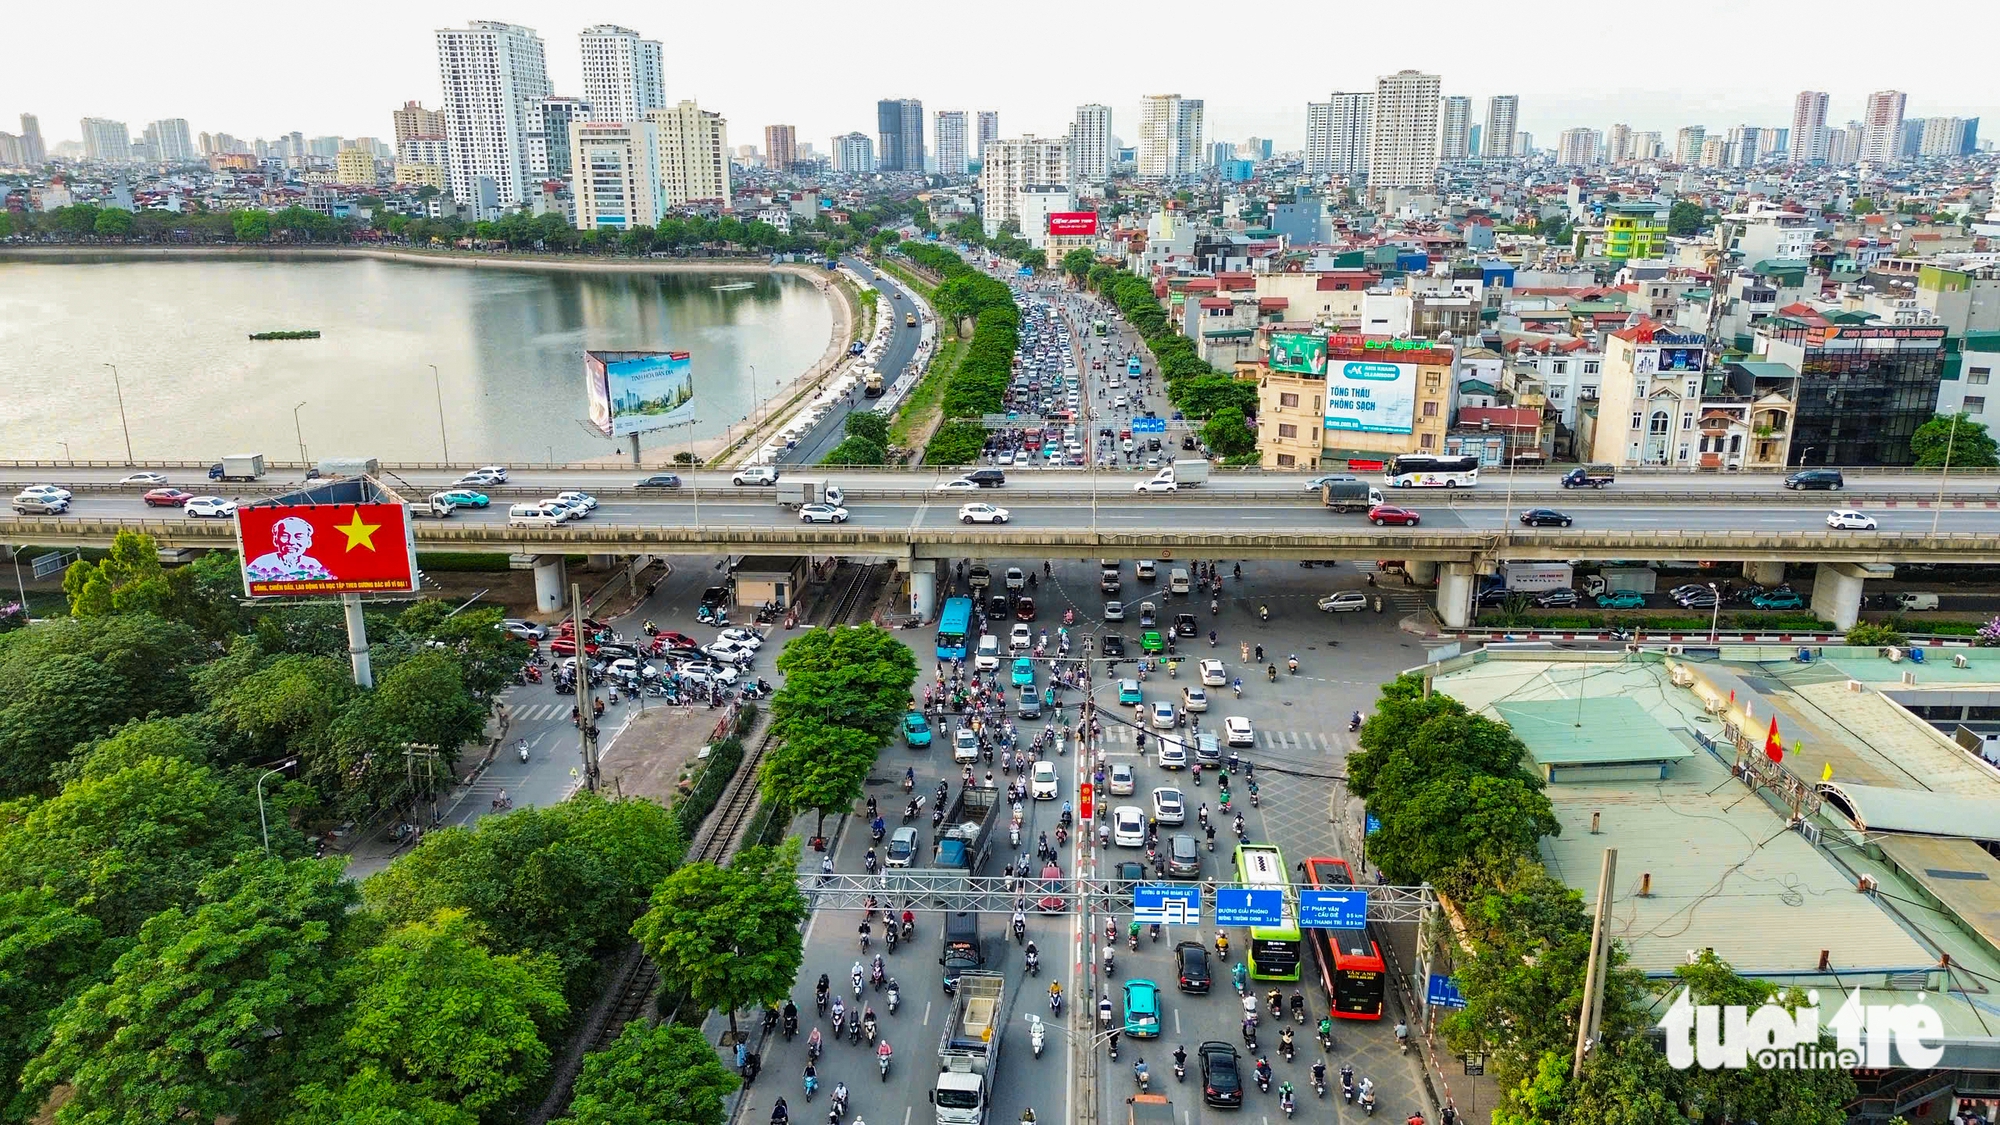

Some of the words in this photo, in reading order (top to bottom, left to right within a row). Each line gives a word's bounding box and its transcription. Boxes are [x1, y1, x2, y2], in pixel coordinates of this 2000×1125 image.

[1911, 329, 1944, 338] BUILDING
[1331, 385, 1349, 397] TỔNG
[1351, 387, 1370, 398] THẦU
[1330, 398, 1354, 410] PHÒNG
[1356, 401, 1376, 412] SẠCH
